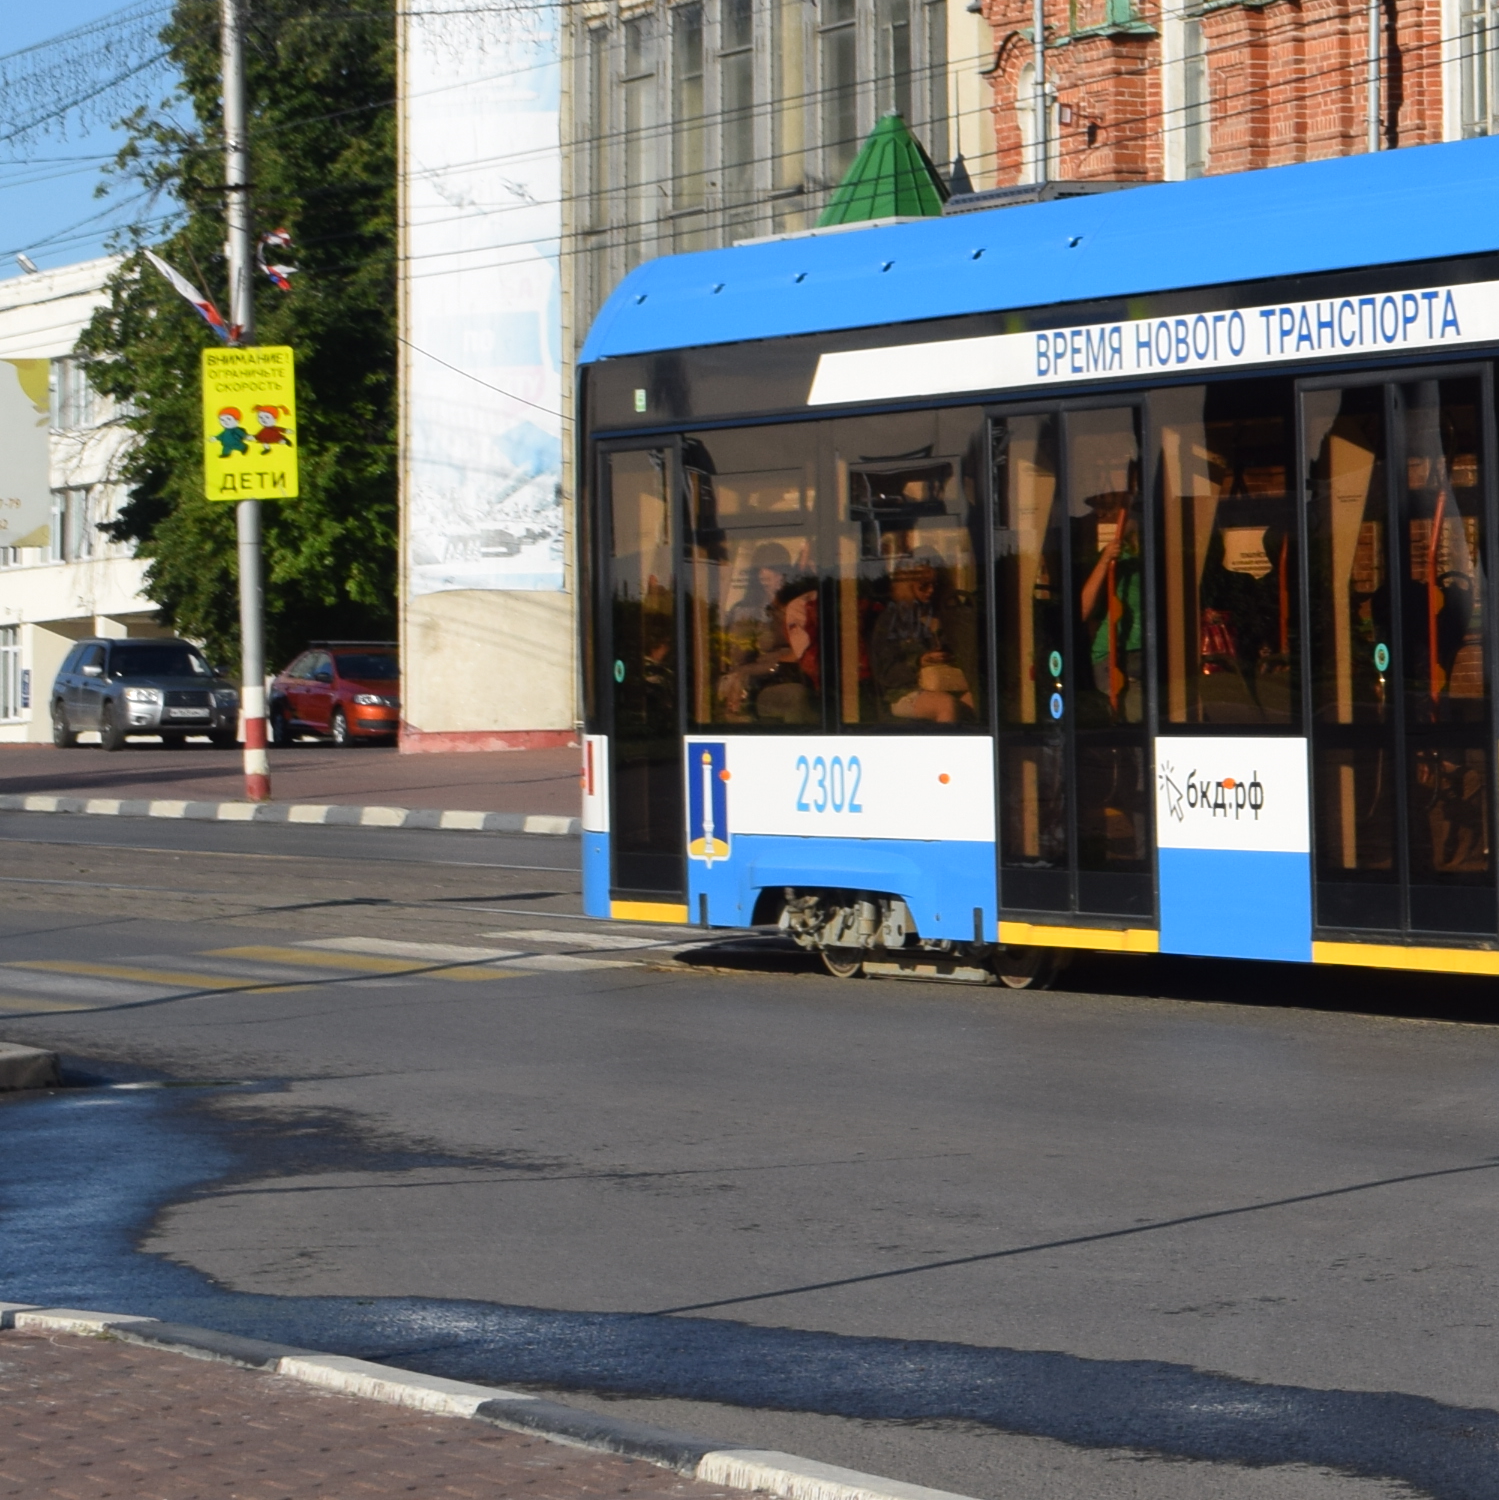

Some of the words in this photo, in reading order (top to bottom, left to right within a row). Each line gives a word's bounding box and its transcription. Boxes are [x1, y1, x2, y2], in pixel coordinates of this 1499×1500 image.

[1036, 325, 1124, 376] ВРЕМЯ
[1135, 310, 1246, 368] НОВОГО
[1260, 289, 1461, 356] ТРАНСПОРТА
[207, 353, 290, 366] ВНИМАНИЕ!
[207, 367, 286, 380] ОГРАНИЧЬТЕ
[215, 381, 283, 393] СКОРОСТЬ
[220, 471, 286, 493] ДЕТИ
[794, 754, 864, 815] 2302
[1186, 768, 1264, 821] бкд.рф
